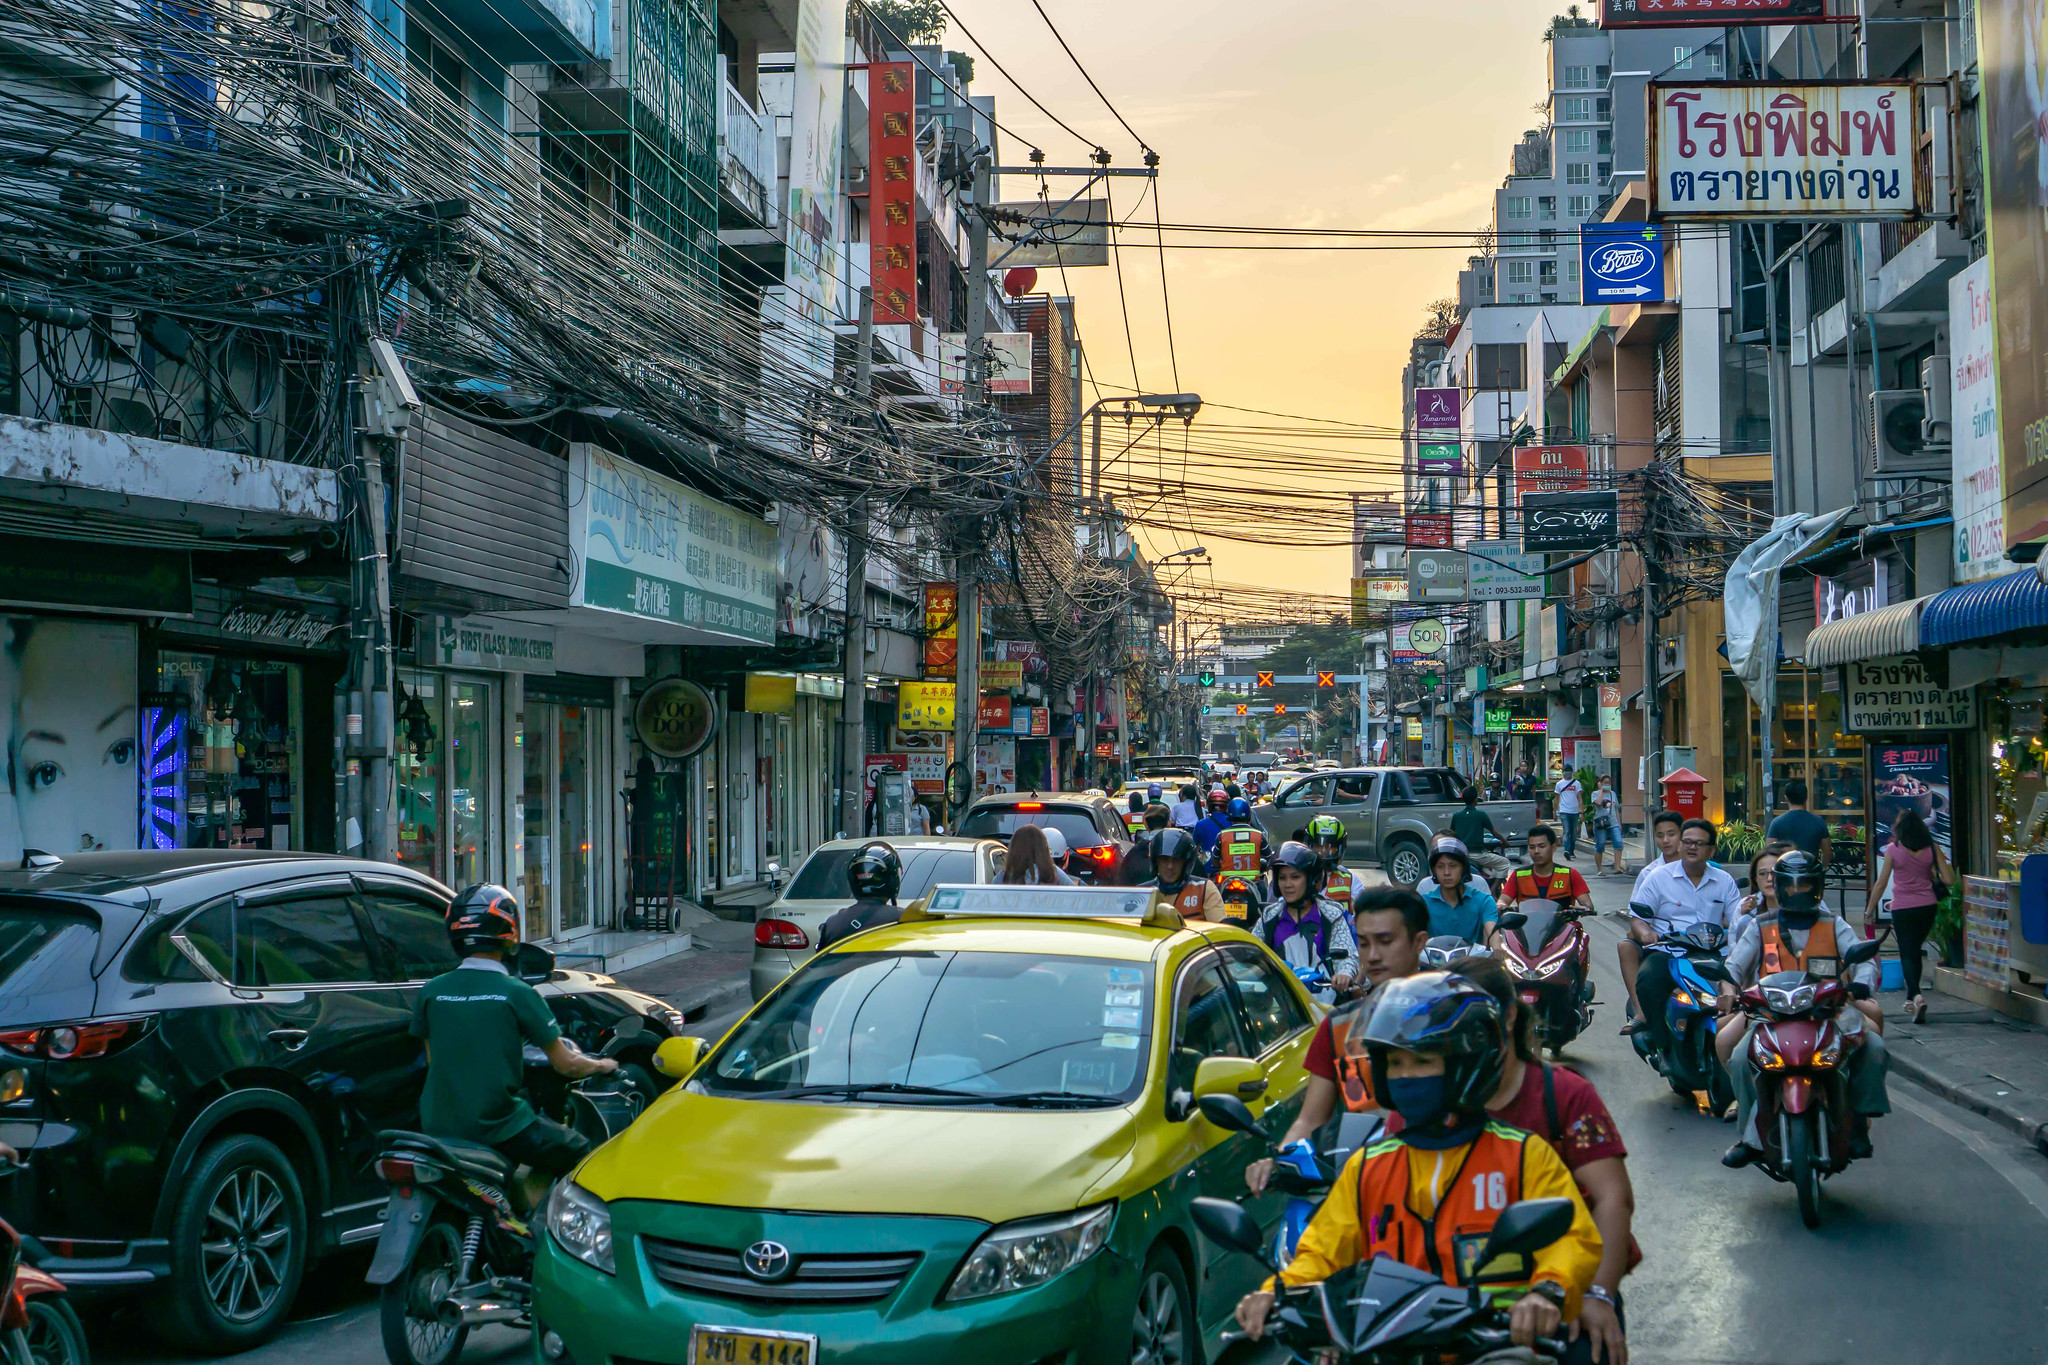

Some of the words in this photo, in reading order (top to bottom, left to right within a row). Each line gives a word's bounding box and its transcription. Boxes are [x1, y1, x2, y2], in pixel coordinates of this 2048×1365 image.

[1665, 91, 1897, 158] โรงพิมพ์
[1670, 160, 1901, 201] ตรายางด่วน
[882, 68, 910, 316] 泰國雲南商會
[1598, 250, 1644, 274] Boots
[1473, 587, 1485, 596] Tel
[1496, 585, 1541, 595] 093-532-8080
[221, 606, 267, 636] Focus
[262, 609, 294, 638] Hair
[289, 613, 333, 649] Design
[461, 629, 481, 653] FIRST
[484, 633, 506, 656] CLASS
[508, 636, 528, 658] DRUG
[529, 639, 554, 661] CENTER
[163, 661, 203, 673] FOCUS
[1512, 721, 1548, 731] EXCHANG
[1883, 748, 1938, 764] 老四川
[1233, 855, 1251, 871] 51
[1553, 879, 1564, 889] 42
[1184, 894, 1198, 907] 46
[1472, 1171, 1507, 1211] 16
